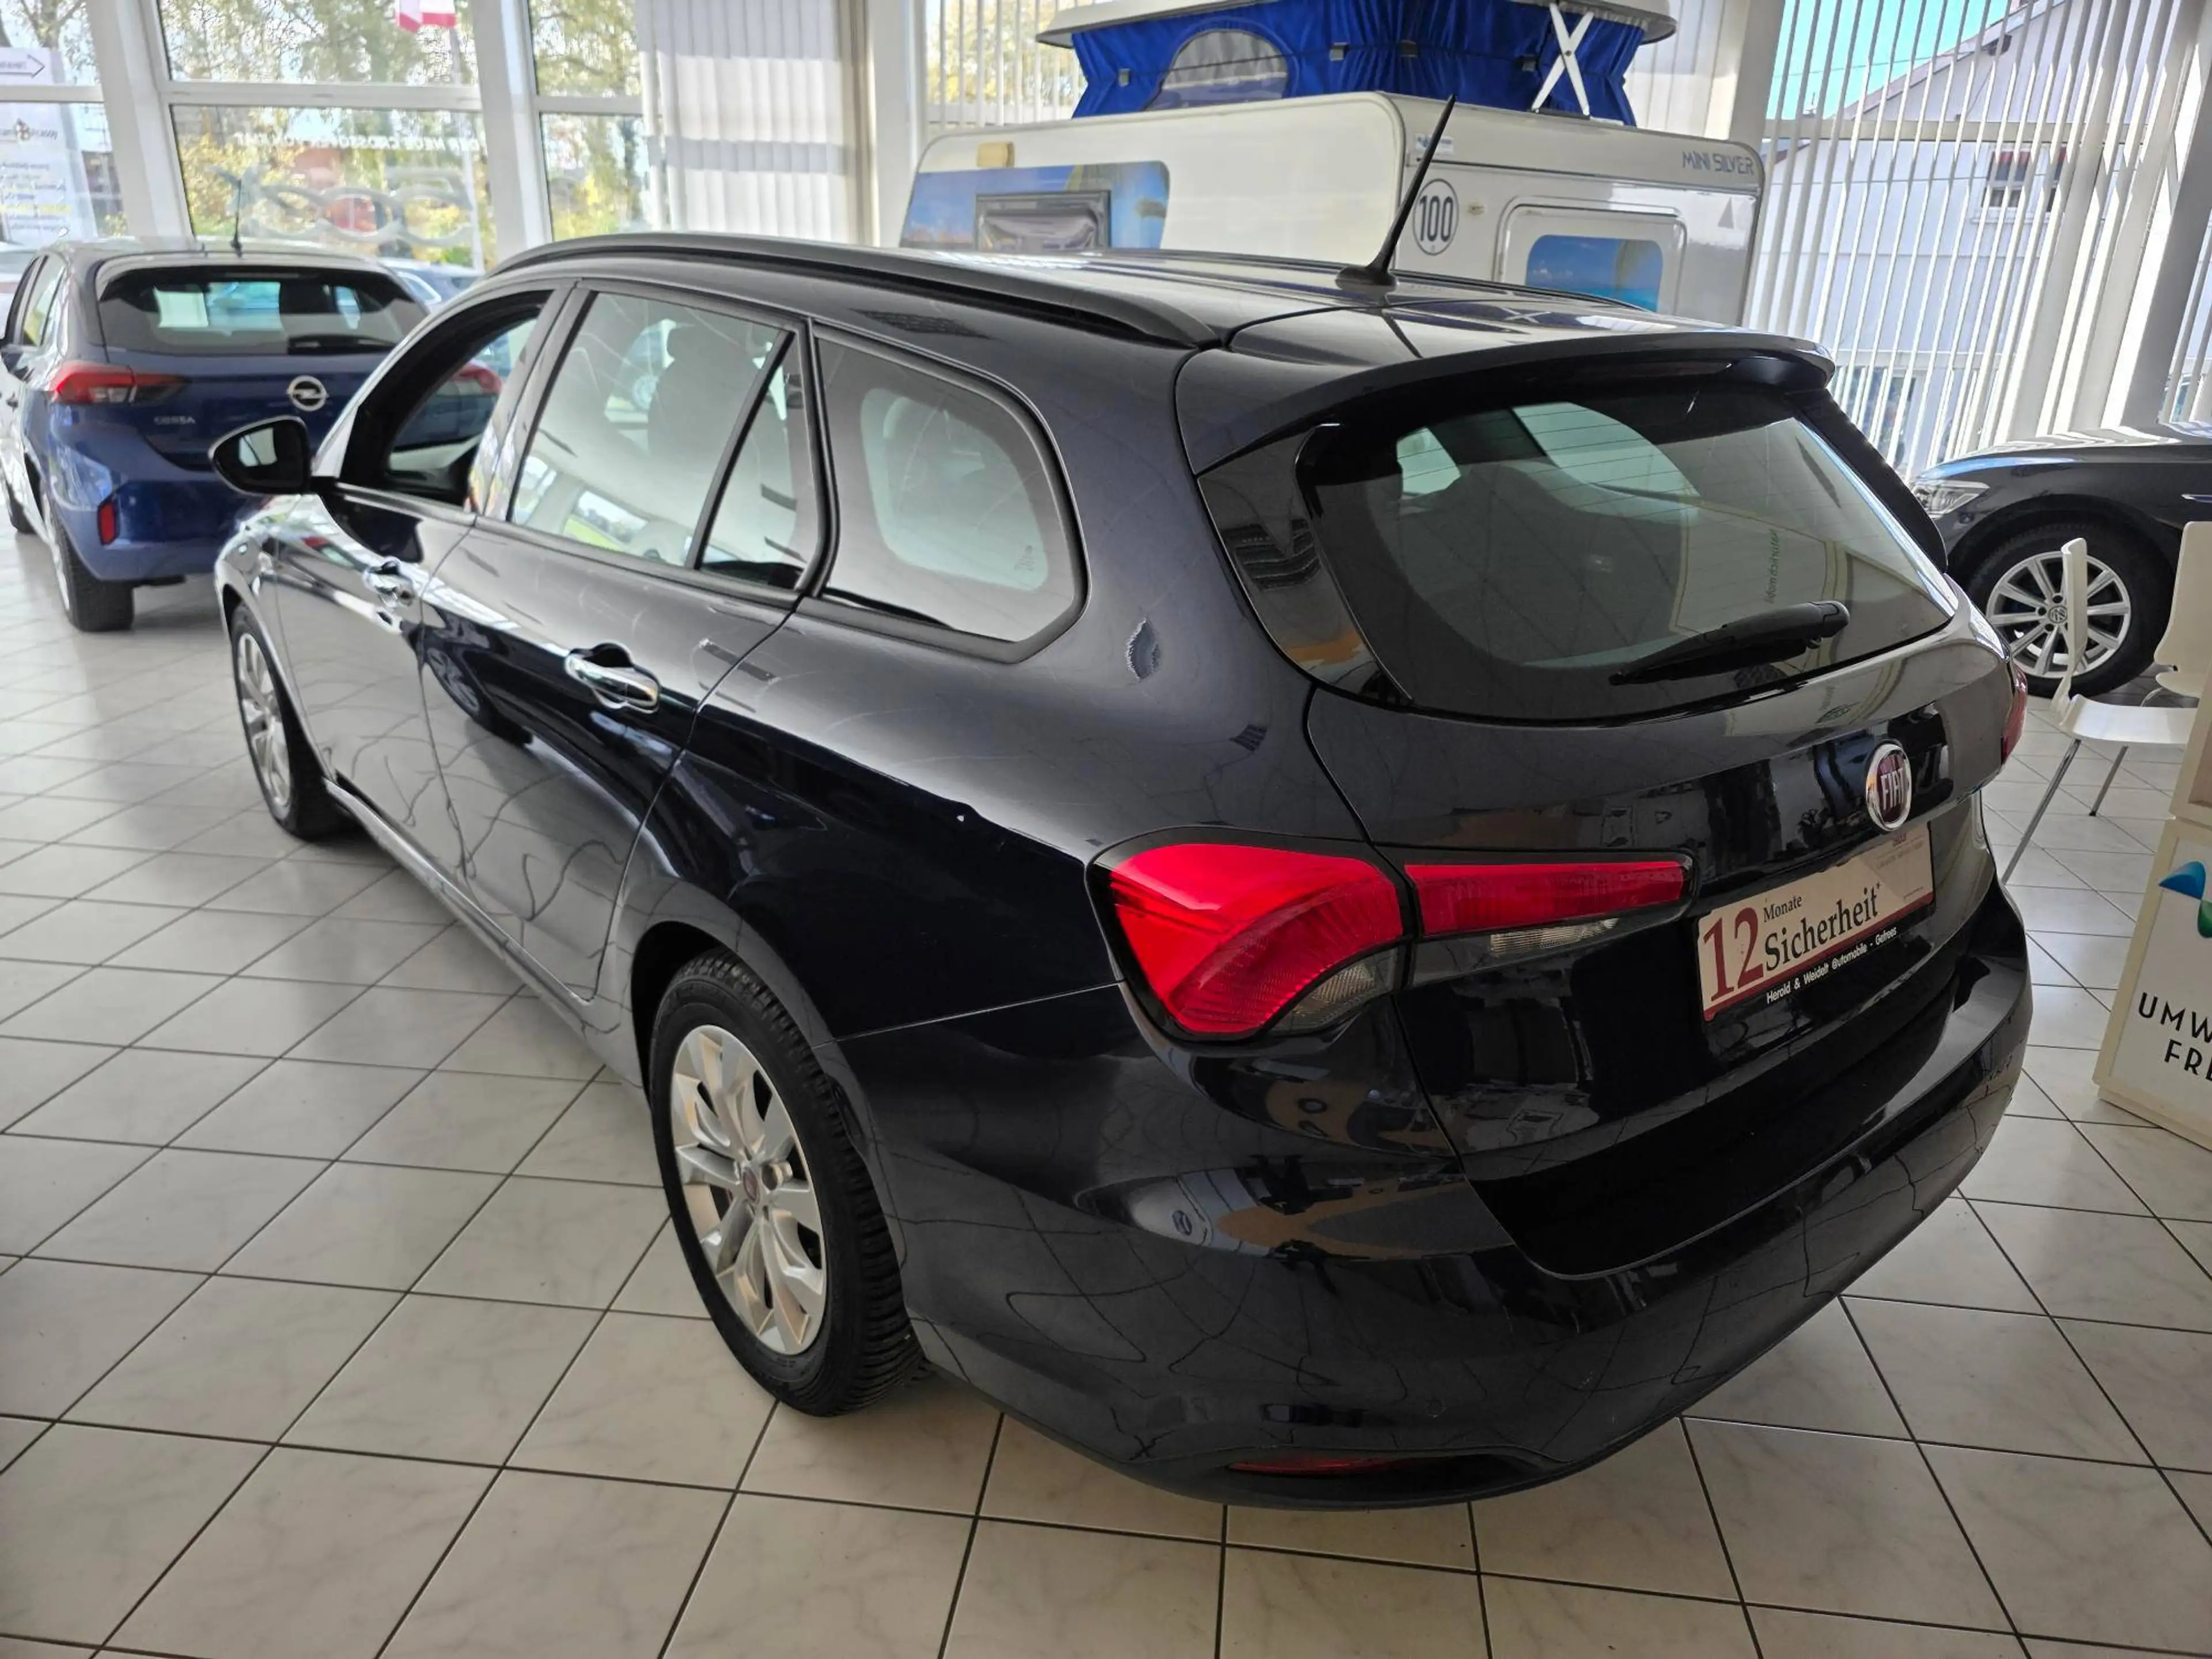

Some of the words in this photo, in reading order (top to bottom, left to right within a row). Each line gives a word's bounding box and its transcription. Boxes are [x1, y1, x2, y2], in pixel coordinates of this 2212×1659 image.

[1713, 153, 1755, 176] SILVER
[1419, 195, 1453, 242] 100
[1880, 767, 1903, 811] FIAT
[1763, 895, 1802, 922] Monate
[1703, 907, 1764, 1001] 12
[1766, 980, 1791, 1004] Herold
[1794, 978, 1801, 990] &
